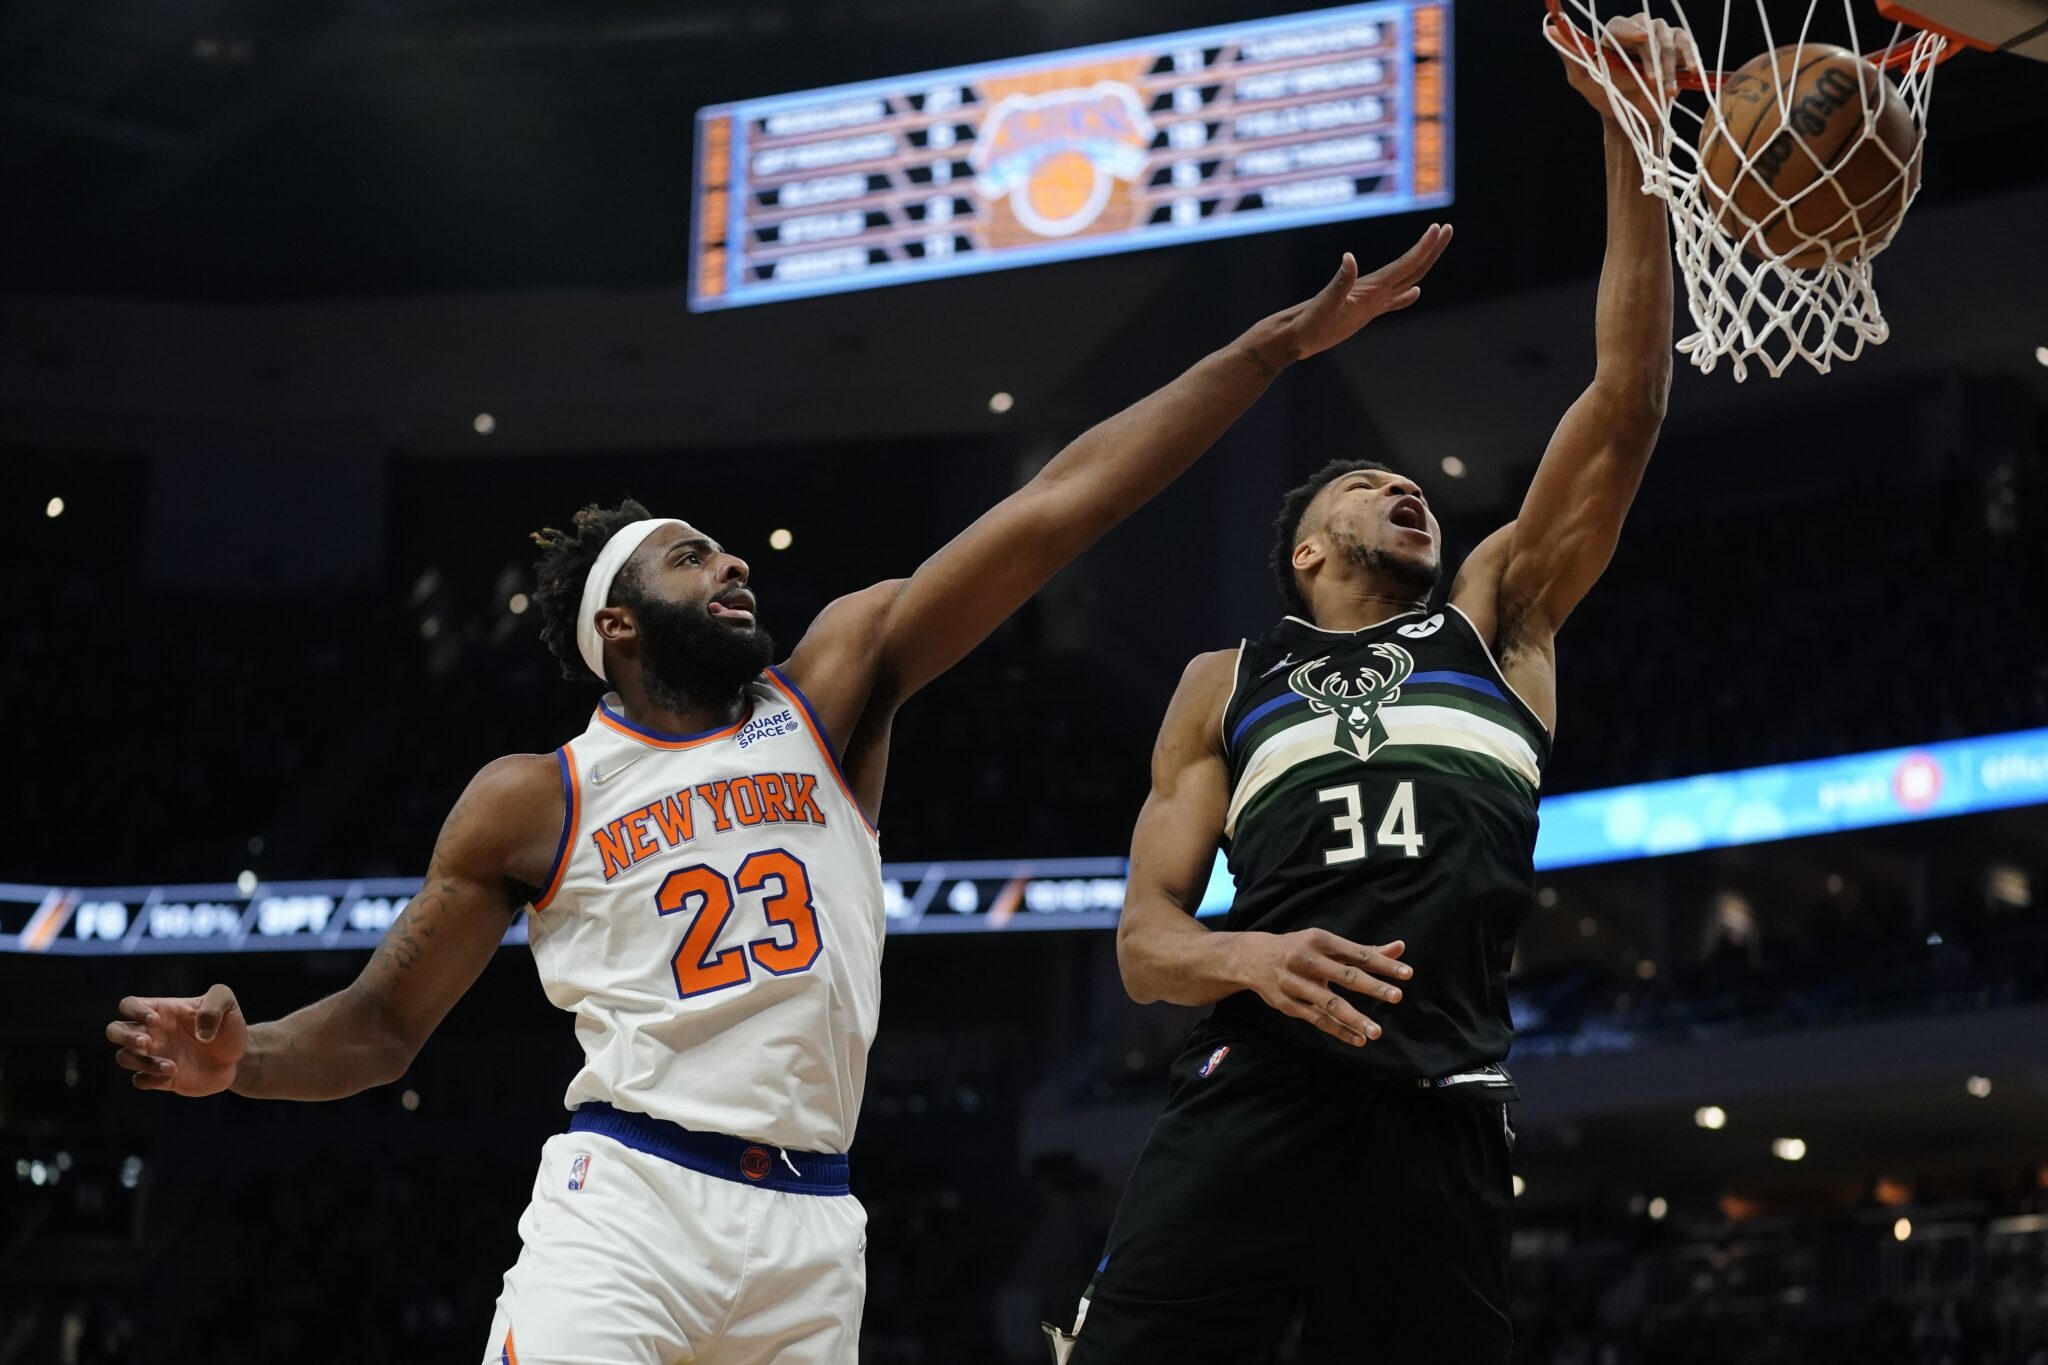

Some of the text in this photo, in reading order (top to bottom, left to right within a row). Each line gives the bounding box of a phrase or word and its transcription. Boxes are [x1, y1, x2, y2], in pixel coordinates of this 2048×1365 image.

[737, 709, 792, 740] SQUARE
[739, 725, 785, 749] SPACE
[592, 772, 827, 883] NEW YORK
[1315, 778, 1426, 866] 34
[655, 848, 823, 1000] 23
